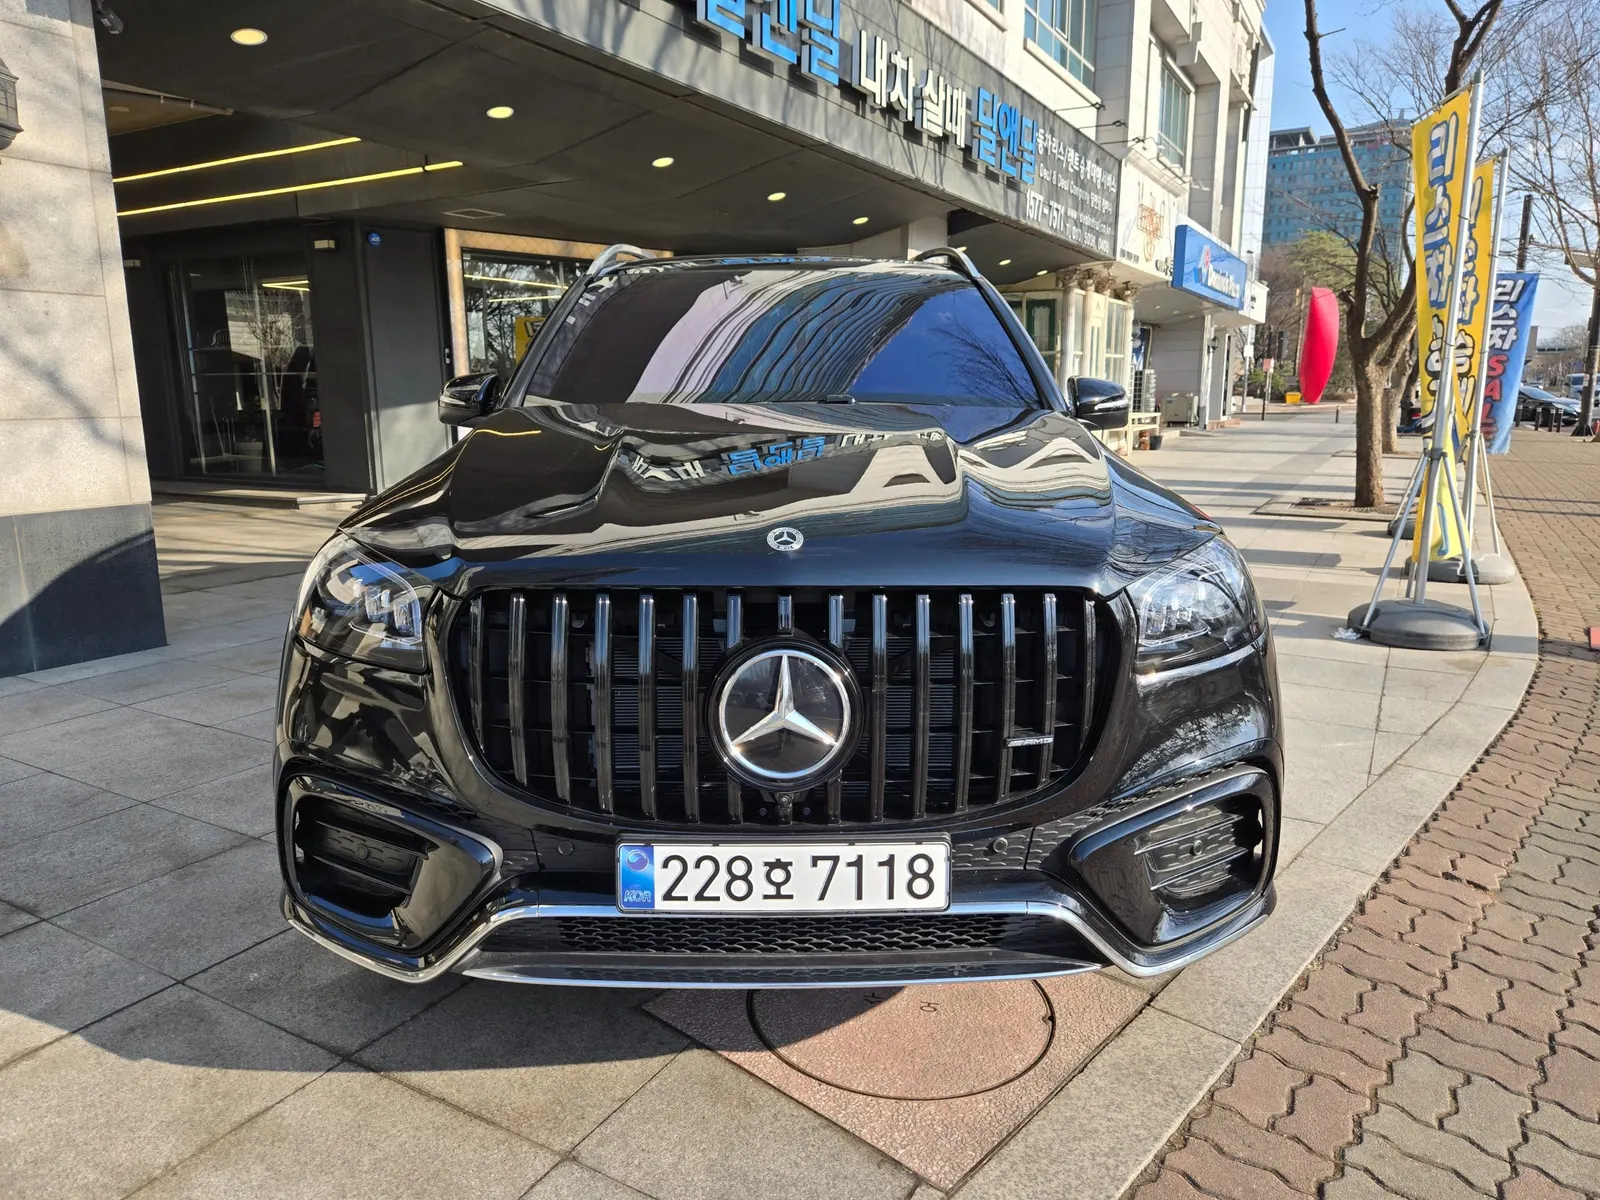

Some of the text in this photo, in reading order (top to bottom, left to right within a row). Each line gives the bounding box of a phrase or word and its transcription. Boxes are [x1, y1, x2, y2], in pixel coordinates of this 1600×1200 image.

[976, 86, 1038, 185] 딜앤딜
[1026, 188, 1065, 232] 1577-7571
[1423, 111, 1460, 310] 리스차
[1488, 278, 1526, 351] 리스차
[624, 890, 652, 902] KOR
[661, 853, 935, 902] 228호 7118
